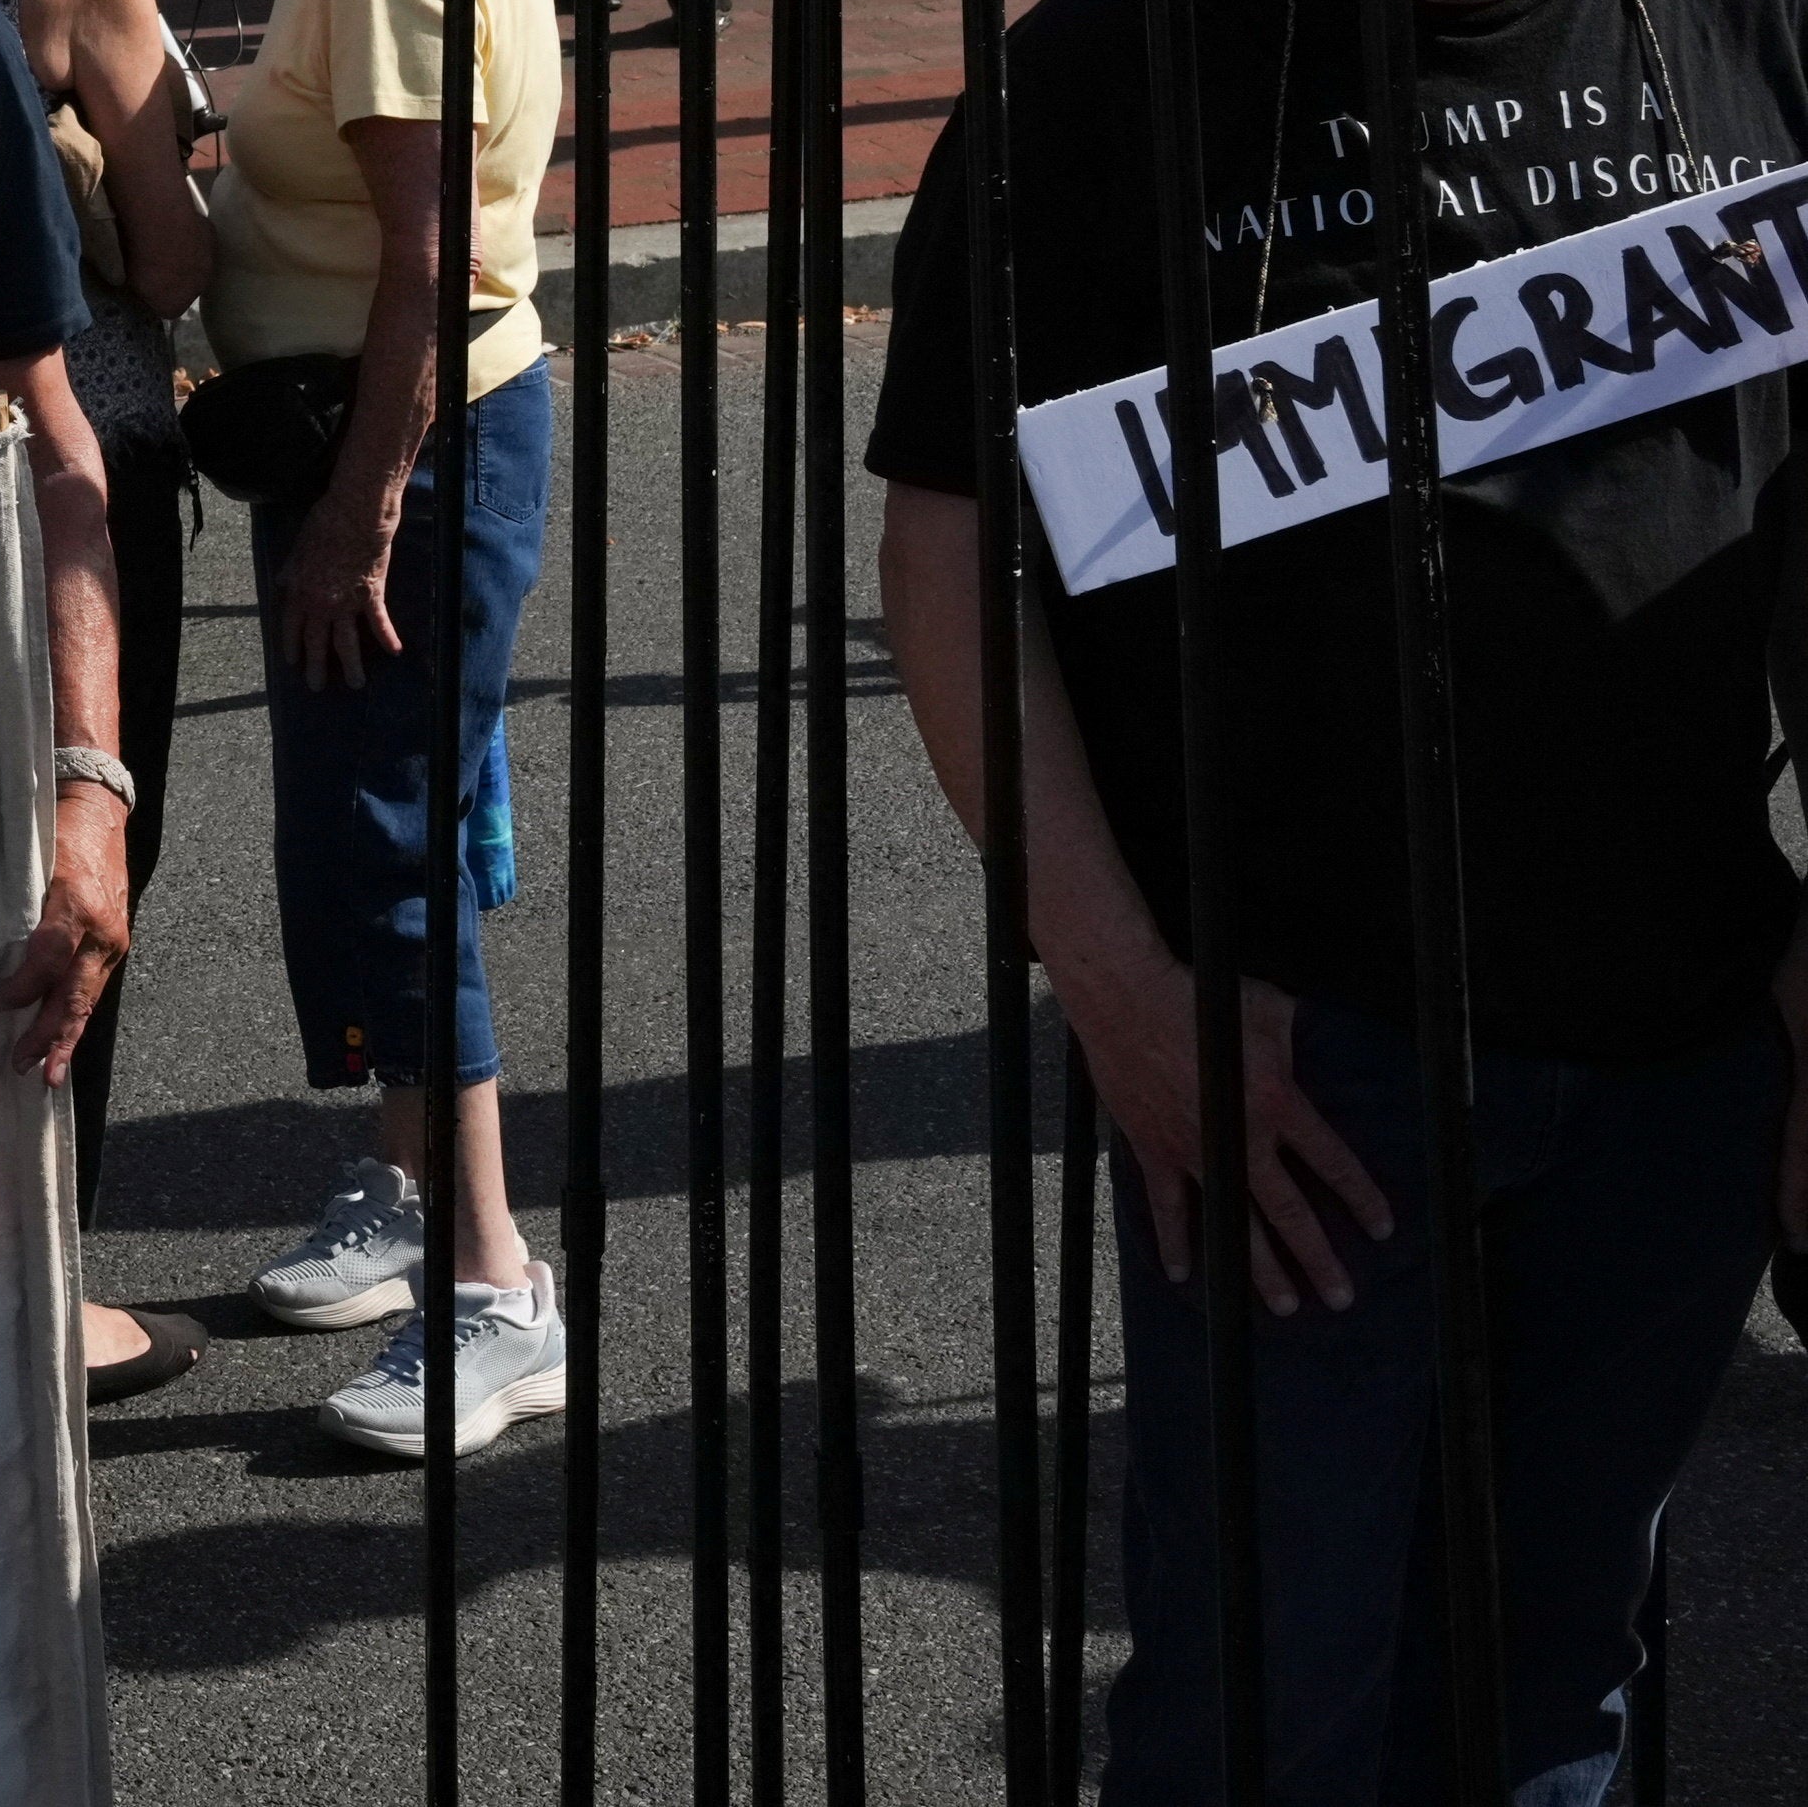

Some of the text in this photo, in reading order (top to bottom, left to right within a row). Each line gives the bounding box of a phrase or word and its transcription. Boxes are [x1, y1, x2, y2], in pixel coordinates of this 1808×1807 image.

[1560, 86, 1609, 130] IS
[1640, 81, 1665, 122] A
[1205, 175, 1497, 253] NATIOAL
